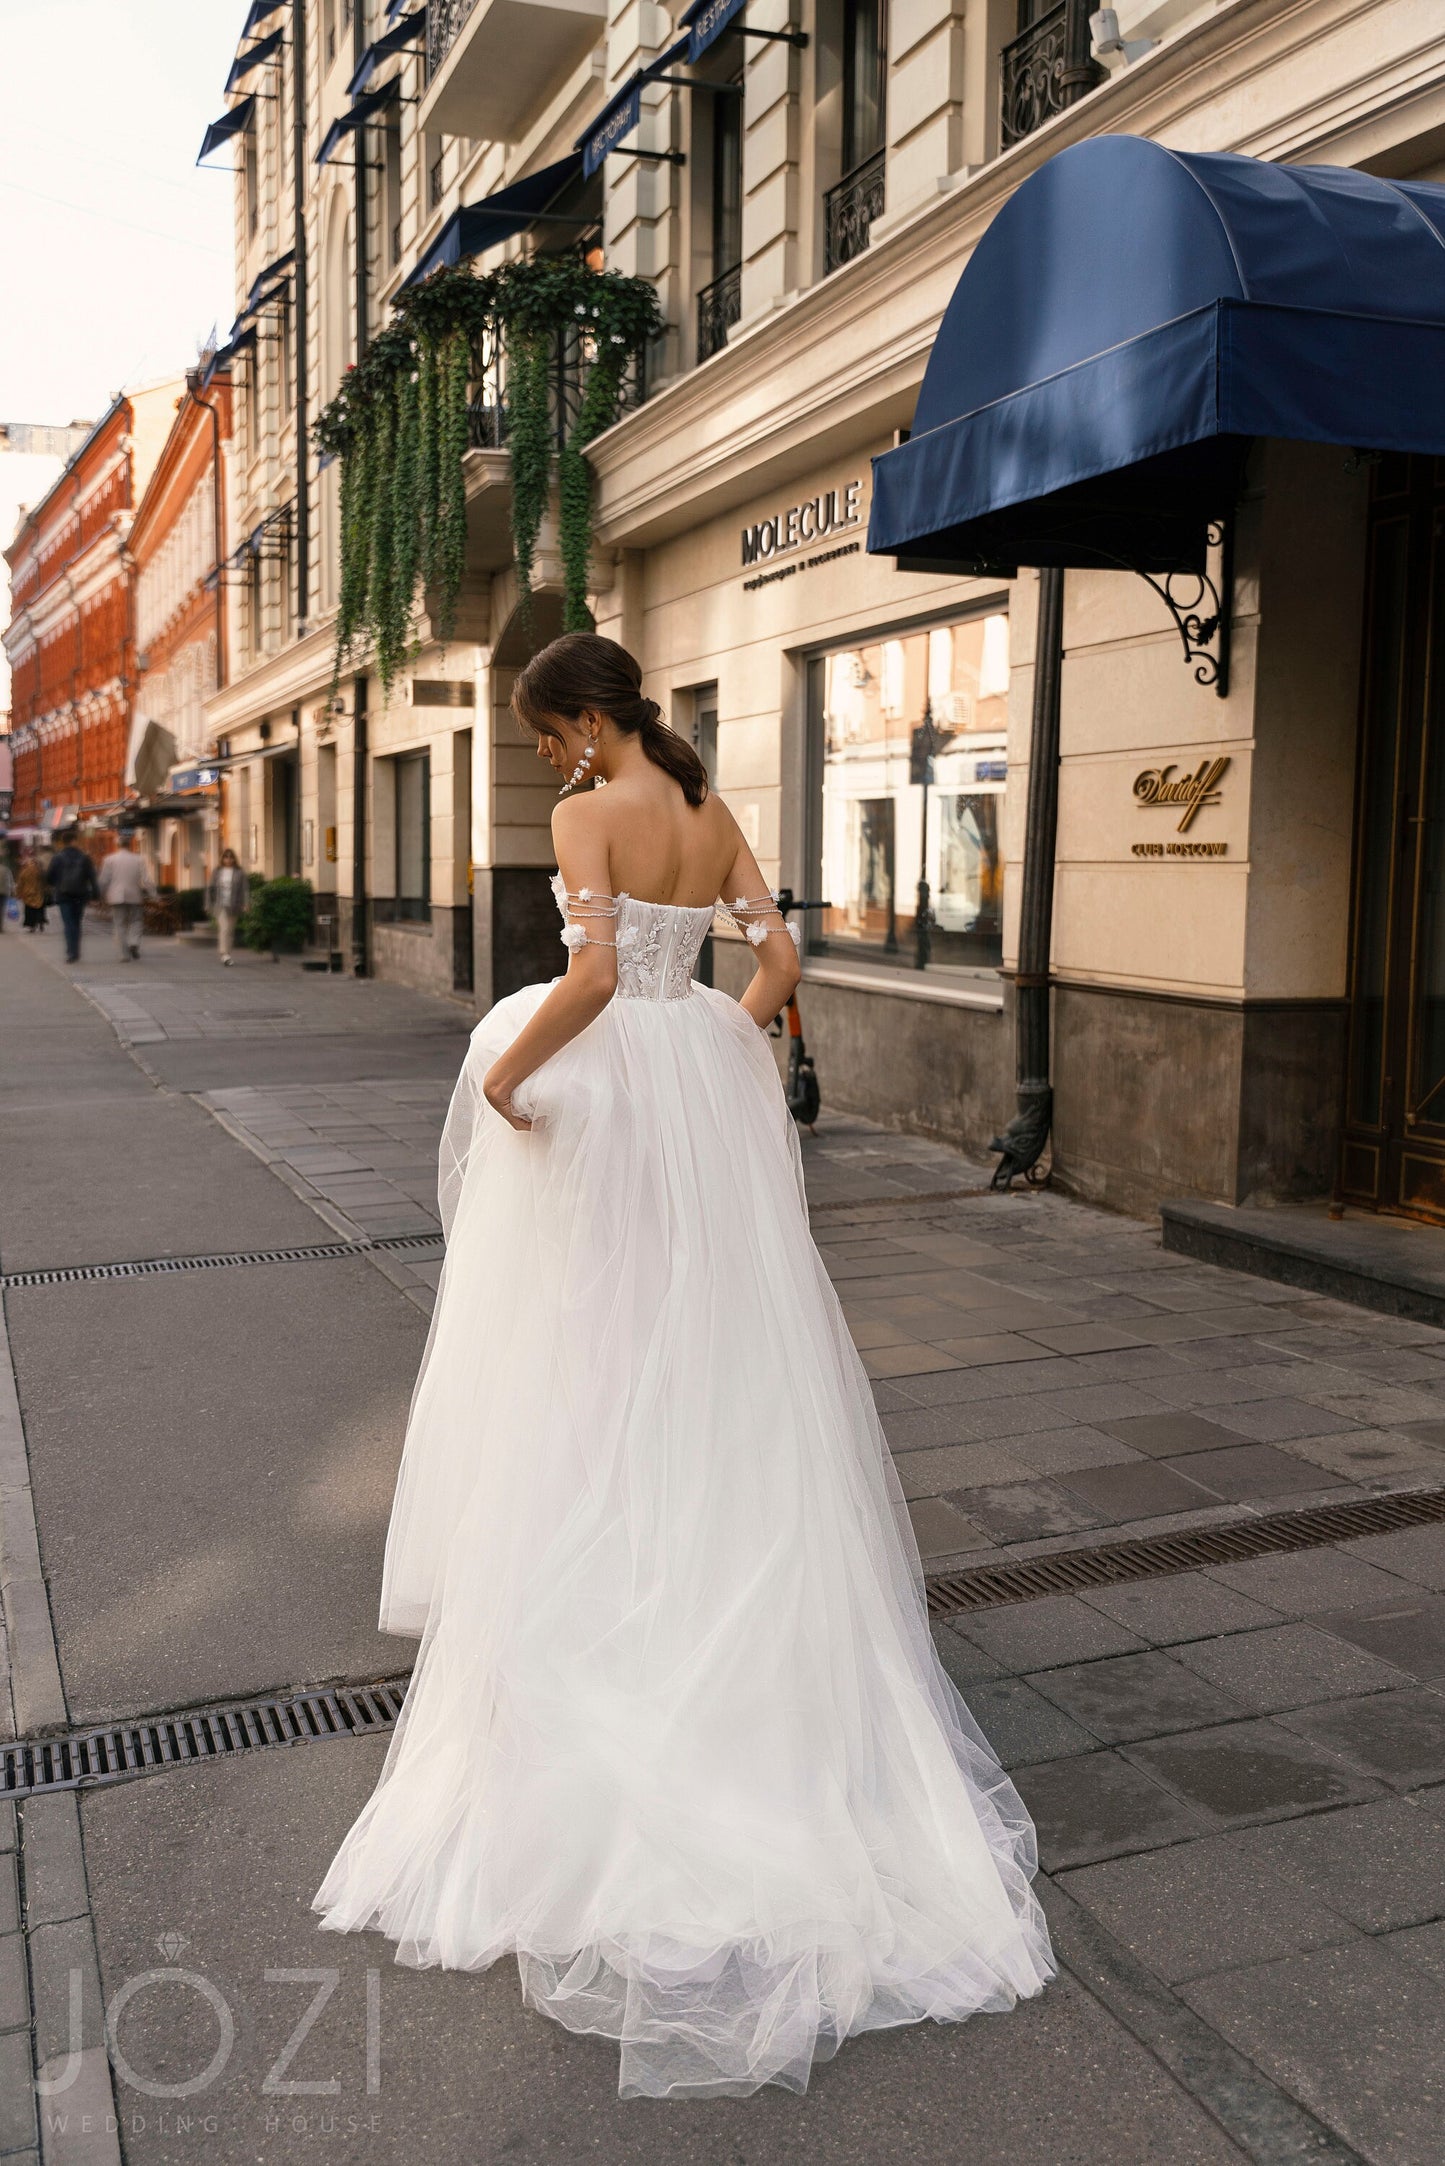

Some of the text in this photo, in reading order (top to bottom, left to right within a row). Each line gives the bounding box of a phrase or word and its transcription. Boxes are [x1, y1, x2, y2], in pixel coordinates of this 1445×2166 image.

[742, 480, 862, 566] MOLECULE
[1131, 843, 1228, 856] CLUB MOSCOW
